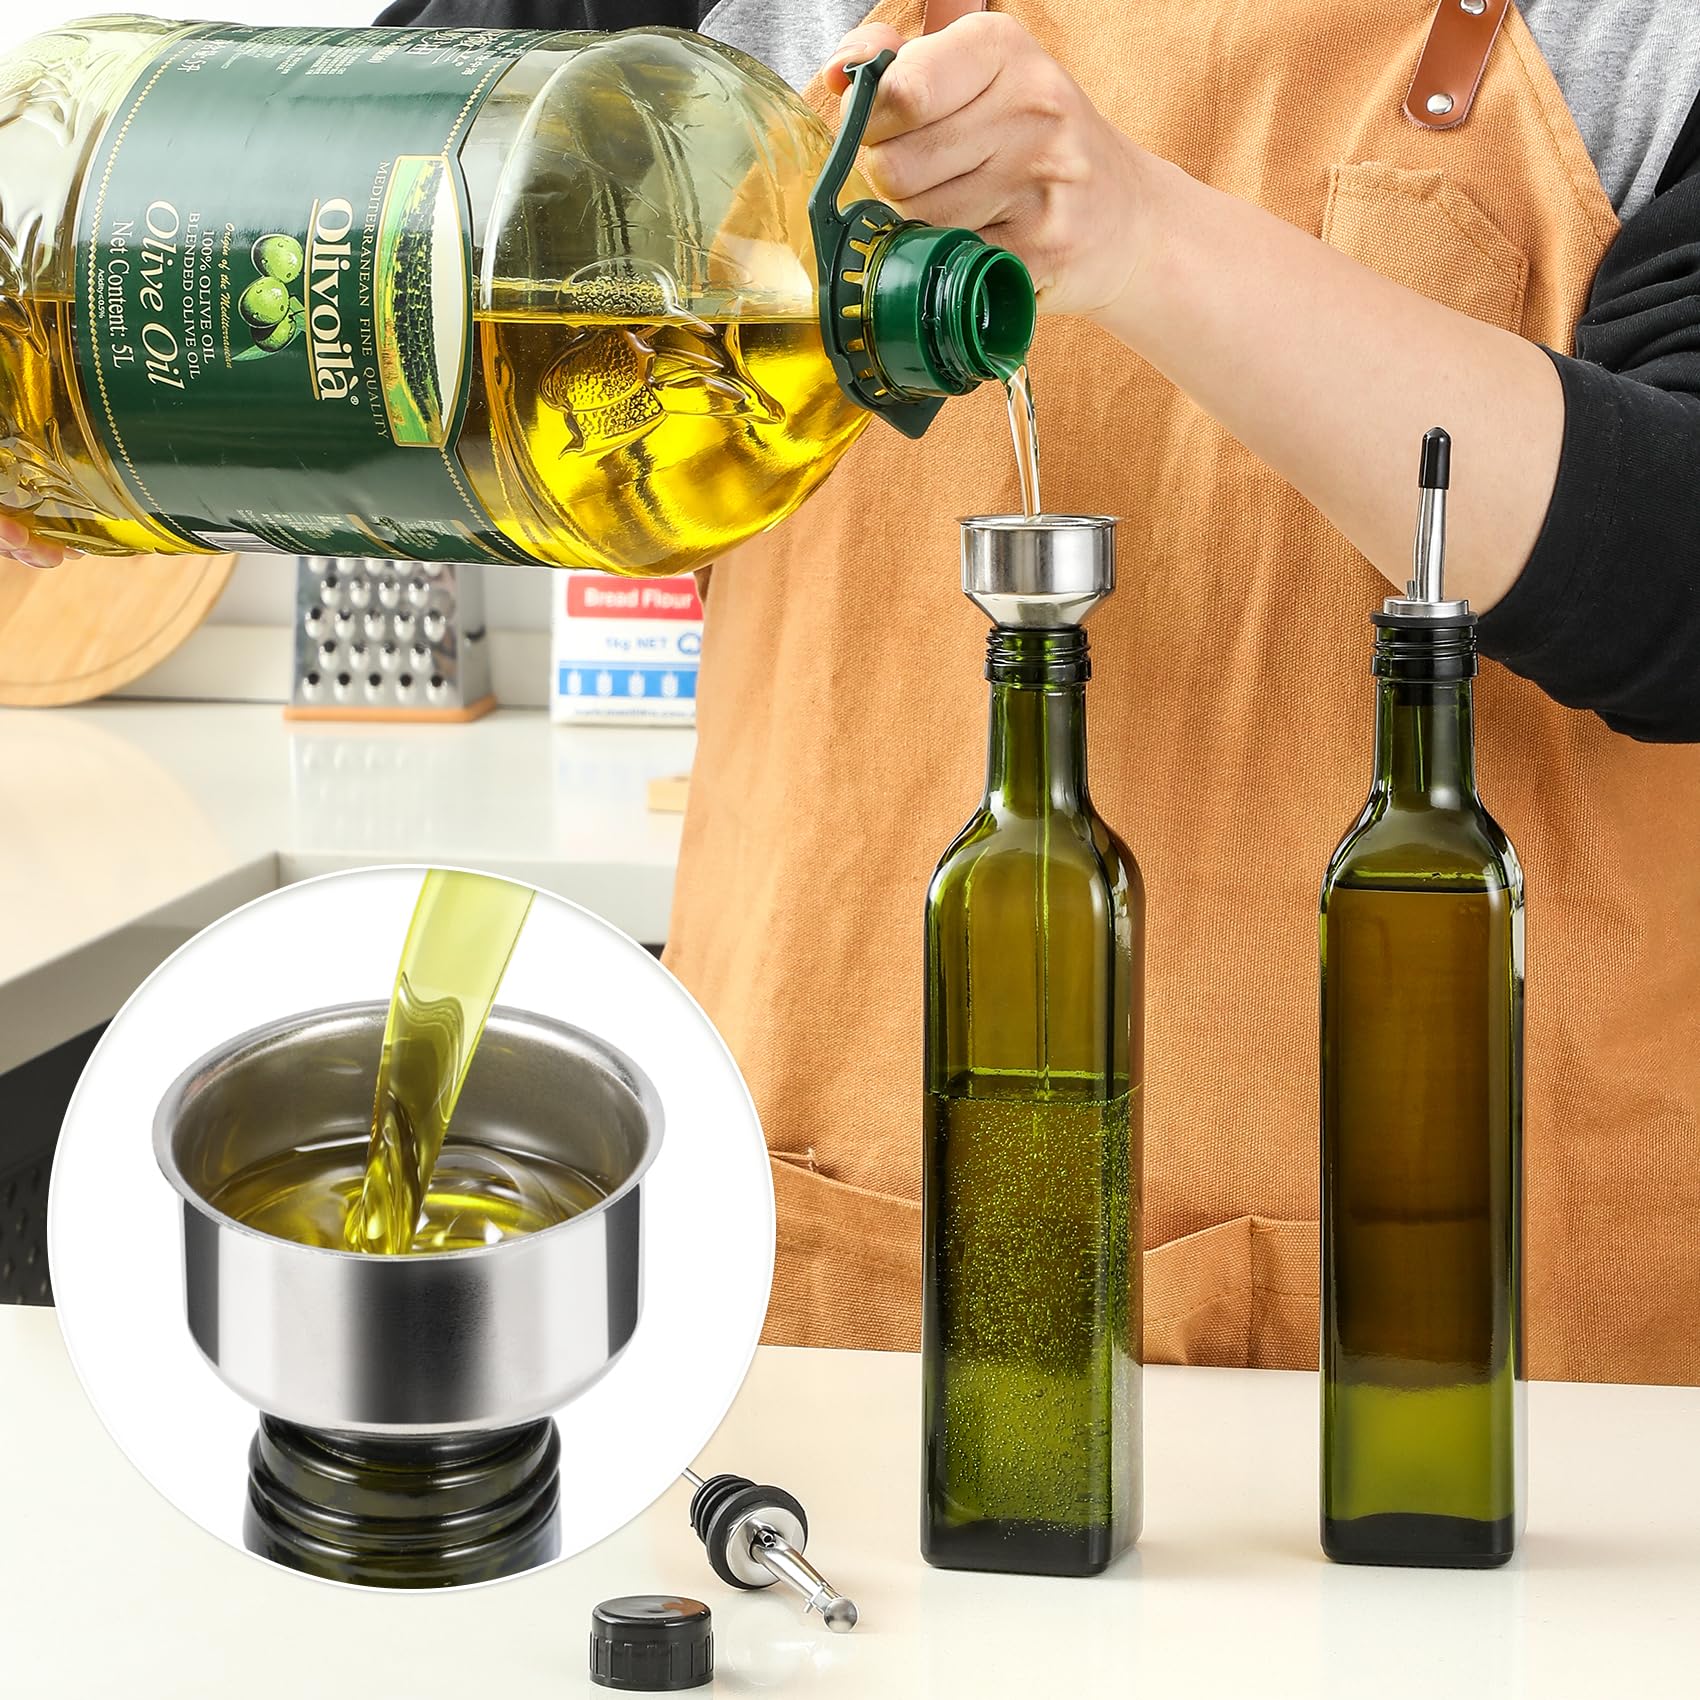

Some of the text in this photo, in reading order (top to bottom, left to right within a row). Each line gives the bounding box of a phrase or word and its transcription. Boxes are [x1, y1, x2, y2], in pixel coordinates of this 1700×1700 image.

[107, 220, 135, 368] Net Content: 5L
[140, 200, 186, 391] Olive Oil
[183, 212, 200, 379] BLENDED OLIVE OIL
[200, 230, 215, 364] 100% OLIVE OIL
[218, 222, 235, 369] Origin of the Mediterranean
[359, 161, 390, 440] MEDITERRANEAN FINE QUALITY
[584, 587, 694, 609] Bread Flour
[637, 637, 668, 649] NET
